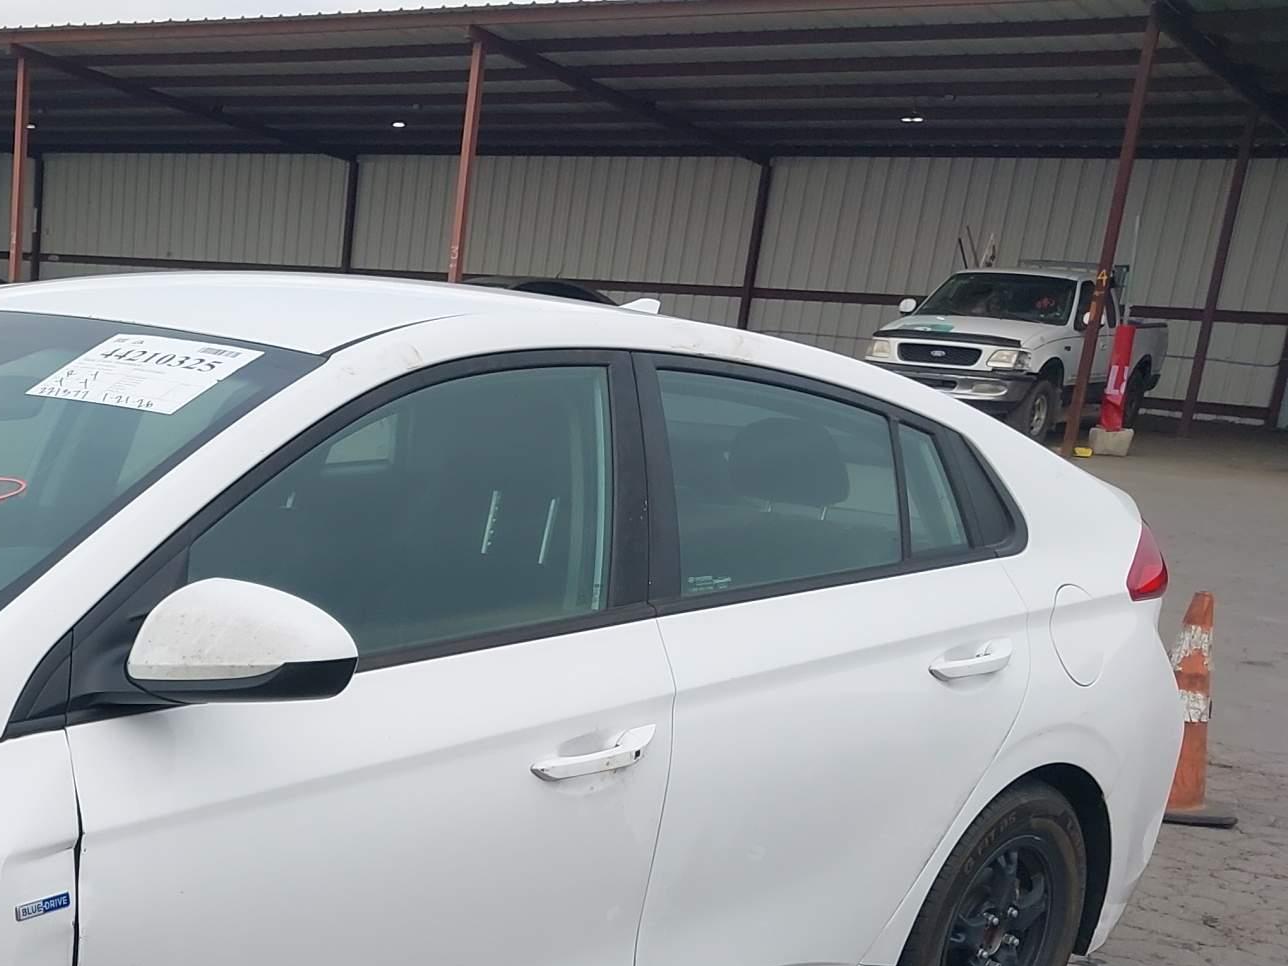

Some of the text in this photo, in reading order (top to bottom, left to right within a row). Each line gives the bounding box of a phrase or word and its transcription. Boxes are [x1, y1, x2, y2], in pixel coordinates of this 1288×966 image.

[1097, 269, 1108, 286] 4
[100, 347, 223, 373] 44210325
[22, 903, 42, 916] BLUE
